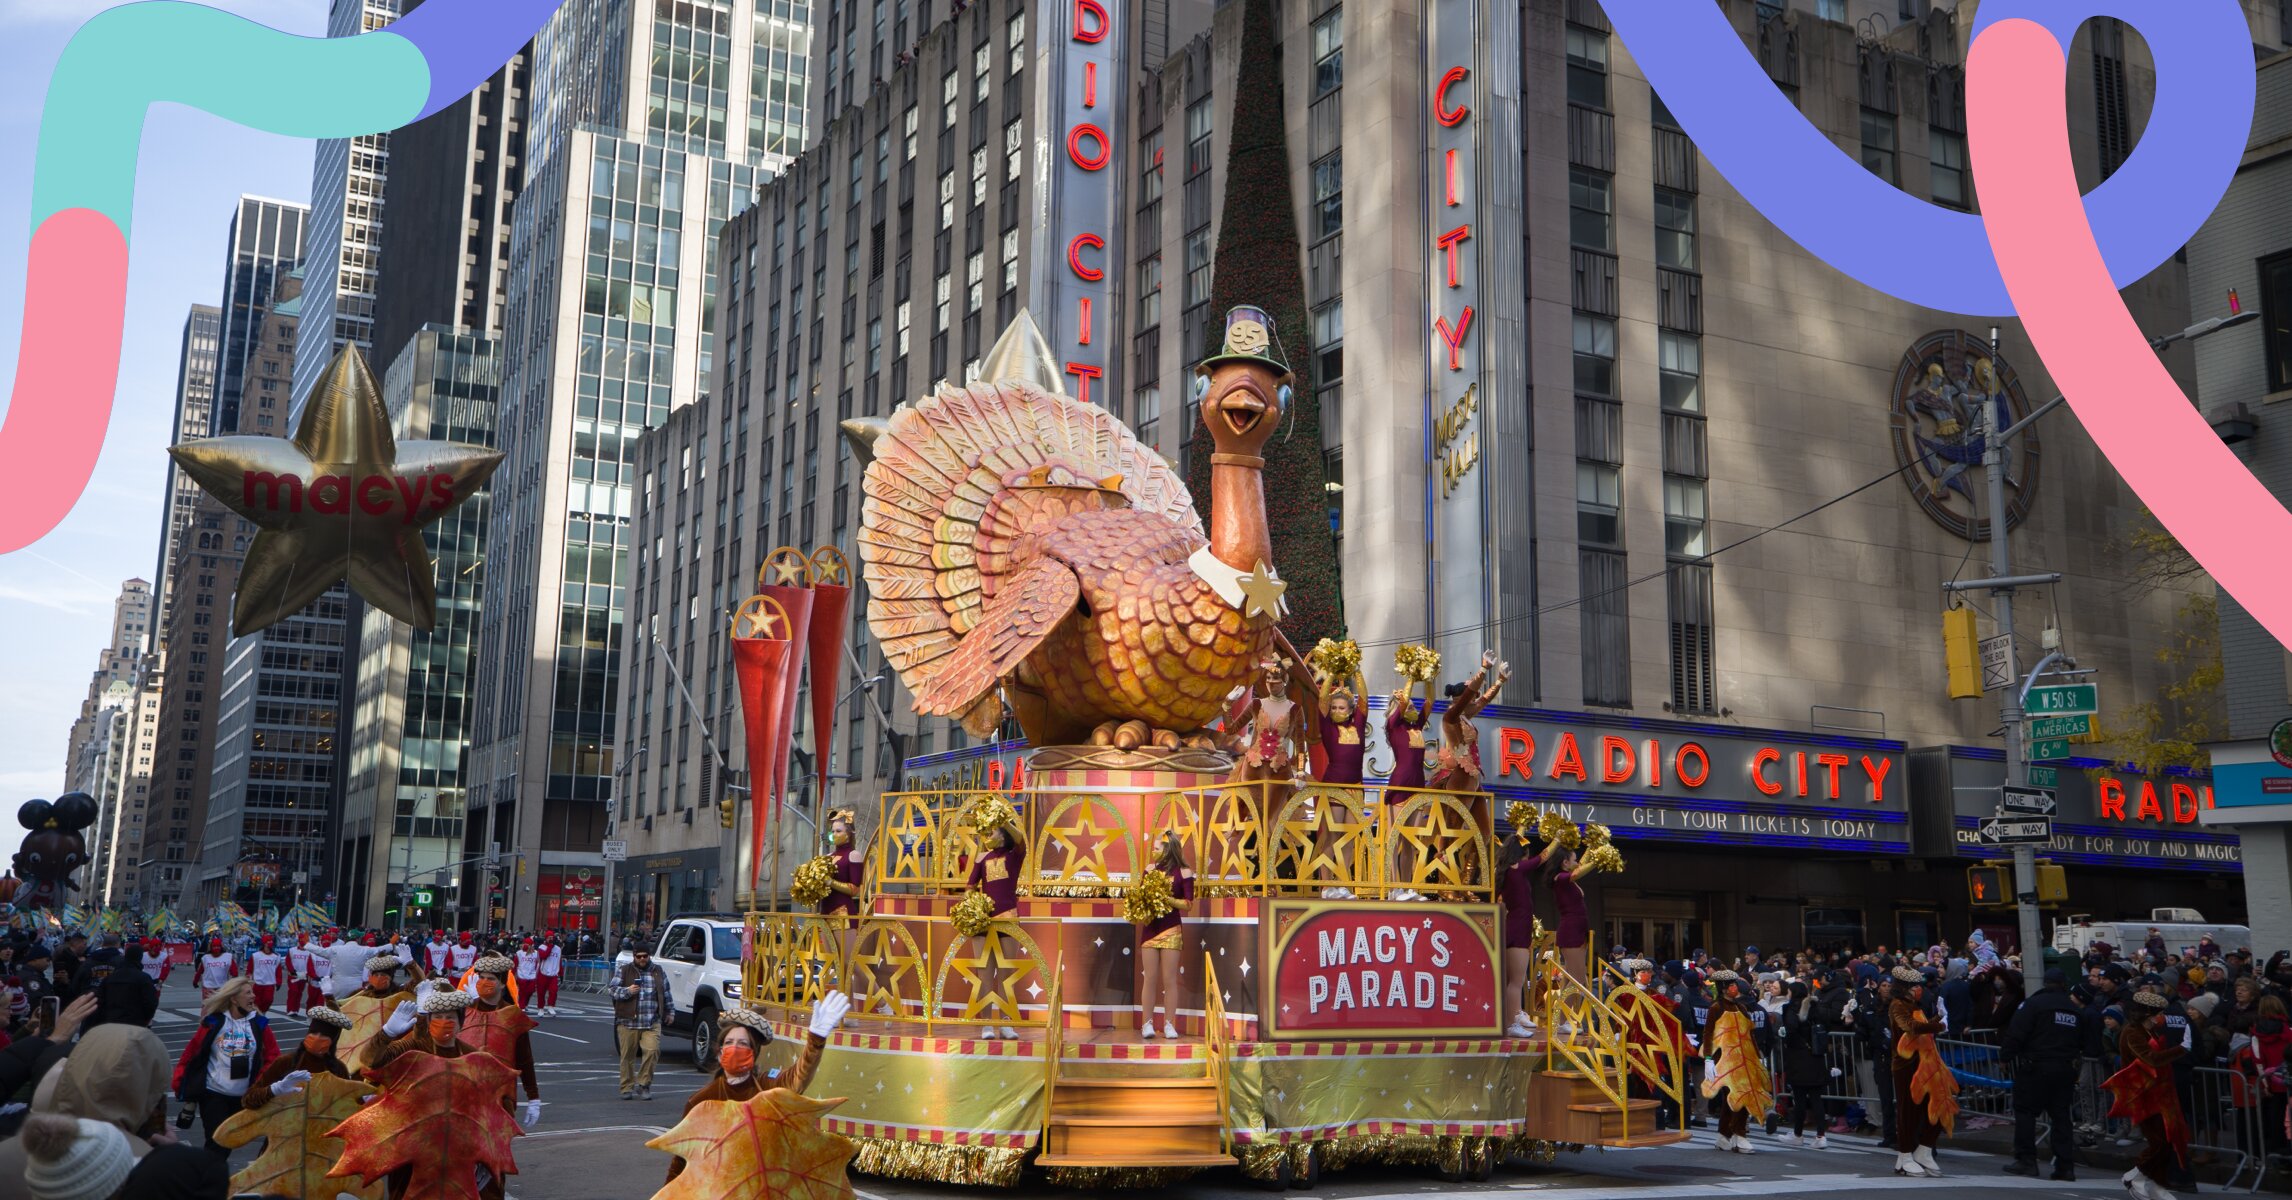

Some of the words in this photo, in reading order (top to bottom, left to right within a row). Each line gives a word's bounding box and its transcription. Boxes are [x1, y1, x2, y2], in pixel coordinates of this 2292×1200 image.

[1433, 65, 1475, 372] CITY
[1433, 381, 1479, 460] MUSIC
[1442, 431, 1480, 499] HALL
[1993, 637, 2010, 652] BLOCK
[1984, 652, 1994, 663] THE
[1994, 649, 2006, 661] BOX
[2041, 692, 2049, 709] W
[2052, 691, 2064, 709] 50
[2067, 690, 2078, 708] St
[2035, 721, 2086, 738] AMERICAS
[2041, 743, 2050, 758] 6
[2052, 740, 2062, 750] AV
[1500, 726, 1711, 791] RADIO
[1752, 746, 1892, 802] CITY
[2032, 768, 2040, 784] W
[2040, 769, 2049, 785] 50
[2007, 793, 2025, 807] ONE
[2034, 796, 2051, 809] WAY
[1585, 804, 1597, 822] 2
[1632, 806, 1667, 826] GET
[1679, 809, 1728, 831] YOUR
[1739, 813, 1811, 836] TICKETS
[1822, 818, 1877, 839] TODAY
[1986, 825, 2010, 837] ONE
[2021, 823, 2045, 836] WAY
[2085, 836, 2115, 853] FOR
[2123, 839, 2151, 856] JOY
[2160, 841, 2188, 858] AND
[416, 892, 433, 904] TD
[2054, 1011, 2077, 1024] NYPD
[2165, 1014, 2187, 1025] NYPD
